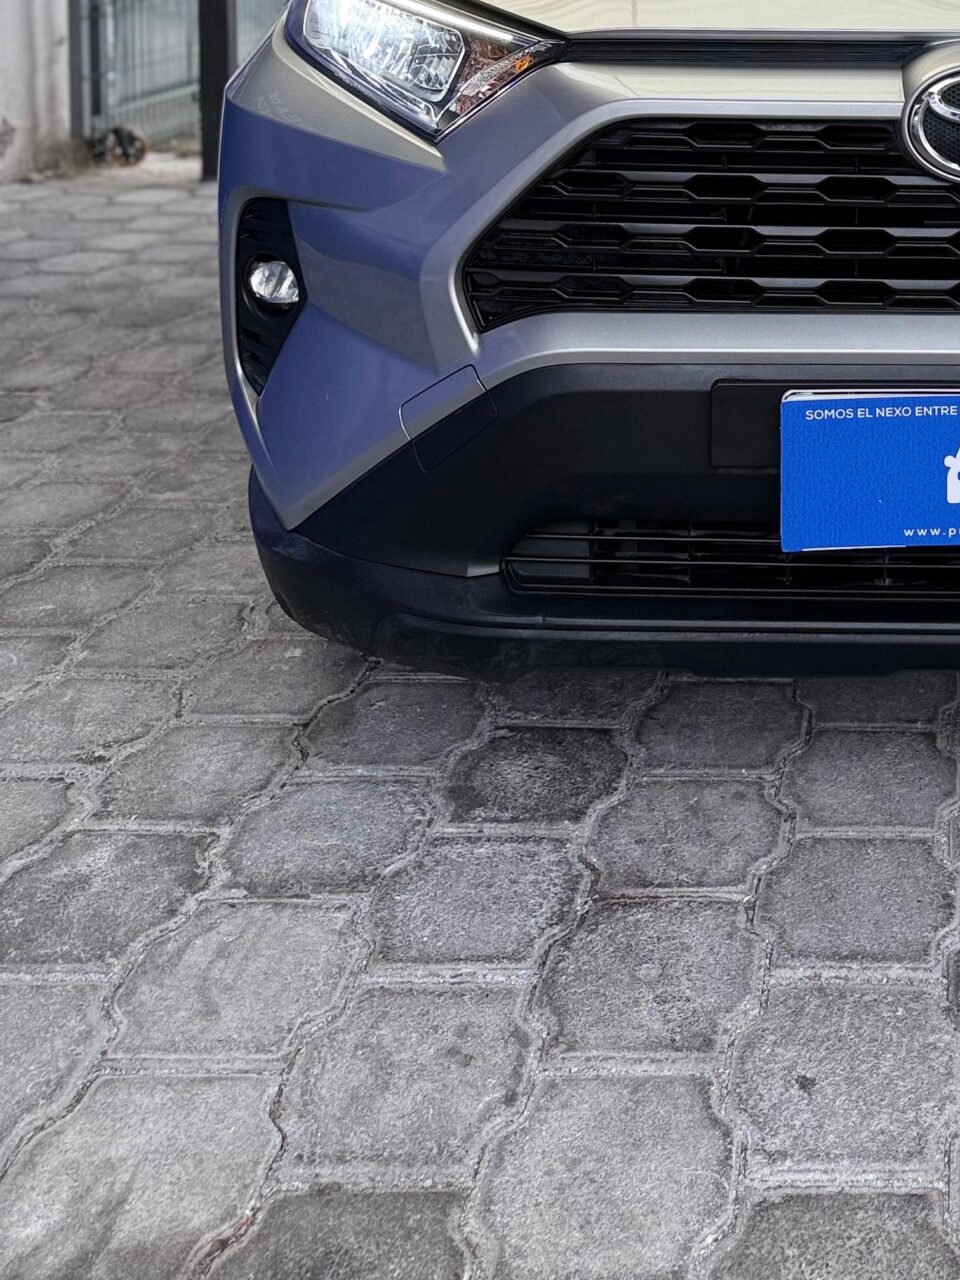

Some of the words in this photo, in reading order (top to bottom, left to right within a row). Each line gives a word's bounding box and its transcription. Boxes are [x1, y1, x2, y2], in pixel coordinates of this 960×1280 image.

[805, 408, 854, 421] SOMOS
[857, 407, 873, 418] EL
[875, 406, 912, 417] NEXO
[914, 405, 958, 417] ENTRE
